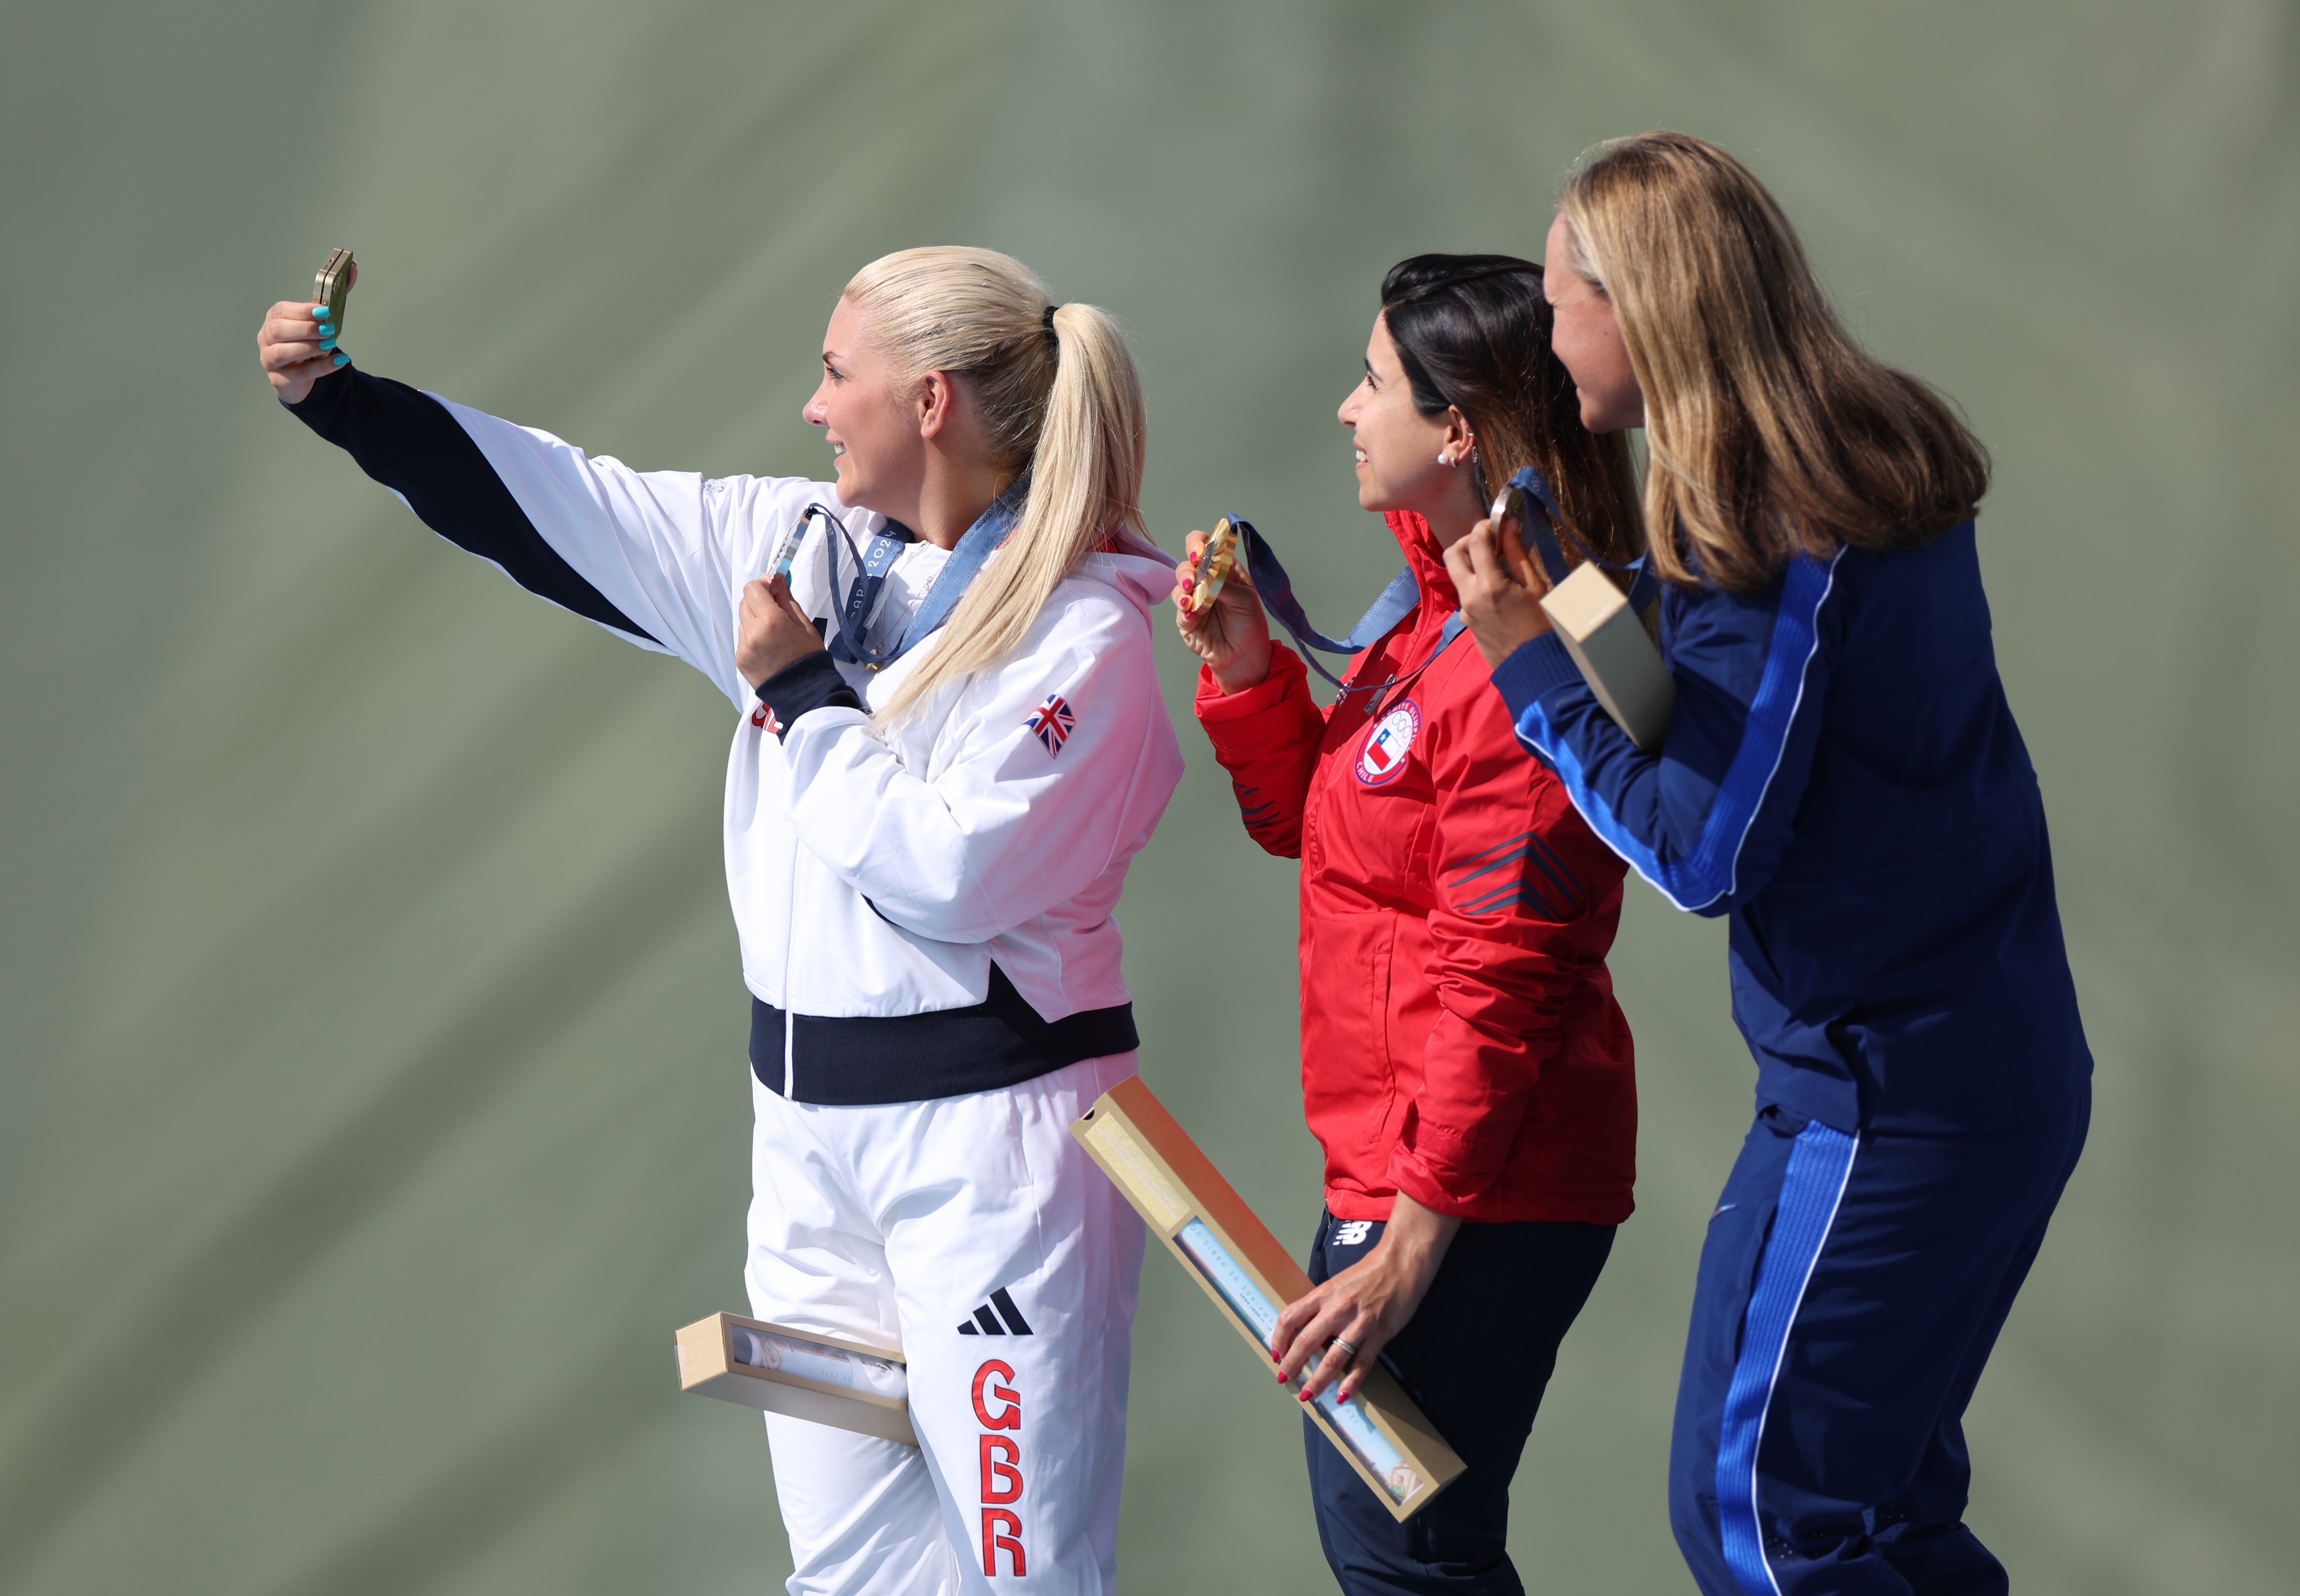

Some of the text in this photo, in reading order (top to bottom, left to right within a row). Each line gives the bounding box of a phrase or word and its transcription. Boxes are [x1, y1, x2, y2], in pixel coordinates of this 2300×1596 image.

[868, 531, 896, 568] 2024
[1356, 761, 1374, 782] CHILE
[1204, 1240, 1226, 1267] PARIS
[1229, 1271, 1239, 1281] DE
[821, 1370, 838, 1379] JEUX
[971, 1359, 1026, 1577] GBR
